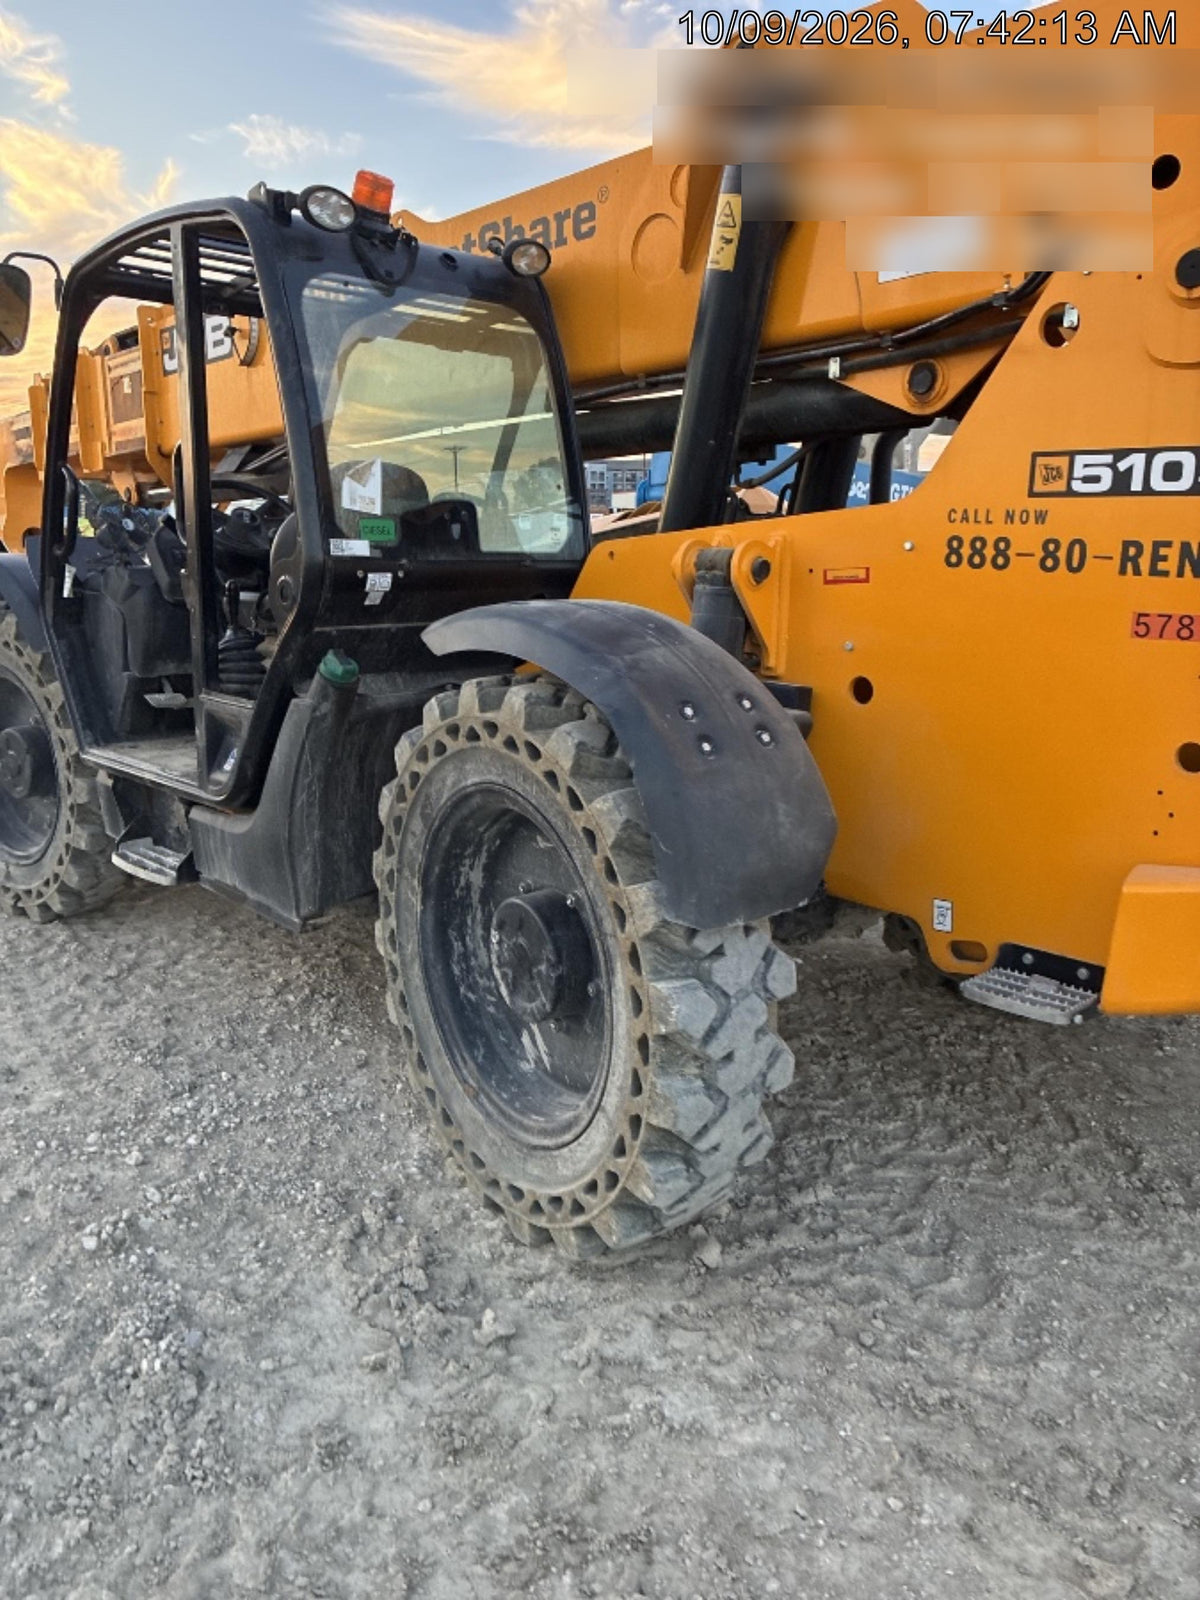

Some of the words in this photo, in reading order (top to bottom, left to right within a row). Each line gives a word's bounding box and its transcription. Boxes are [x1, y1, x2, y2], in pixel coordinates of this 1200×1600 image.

[162, 314, 233, 372] JB
[1070, 451, 1200, 493] 510
[947, 508, 994, 525] CALL
[1004, 509, 1048, 525] NOW
[1133, 612, 1195, 641] 578
